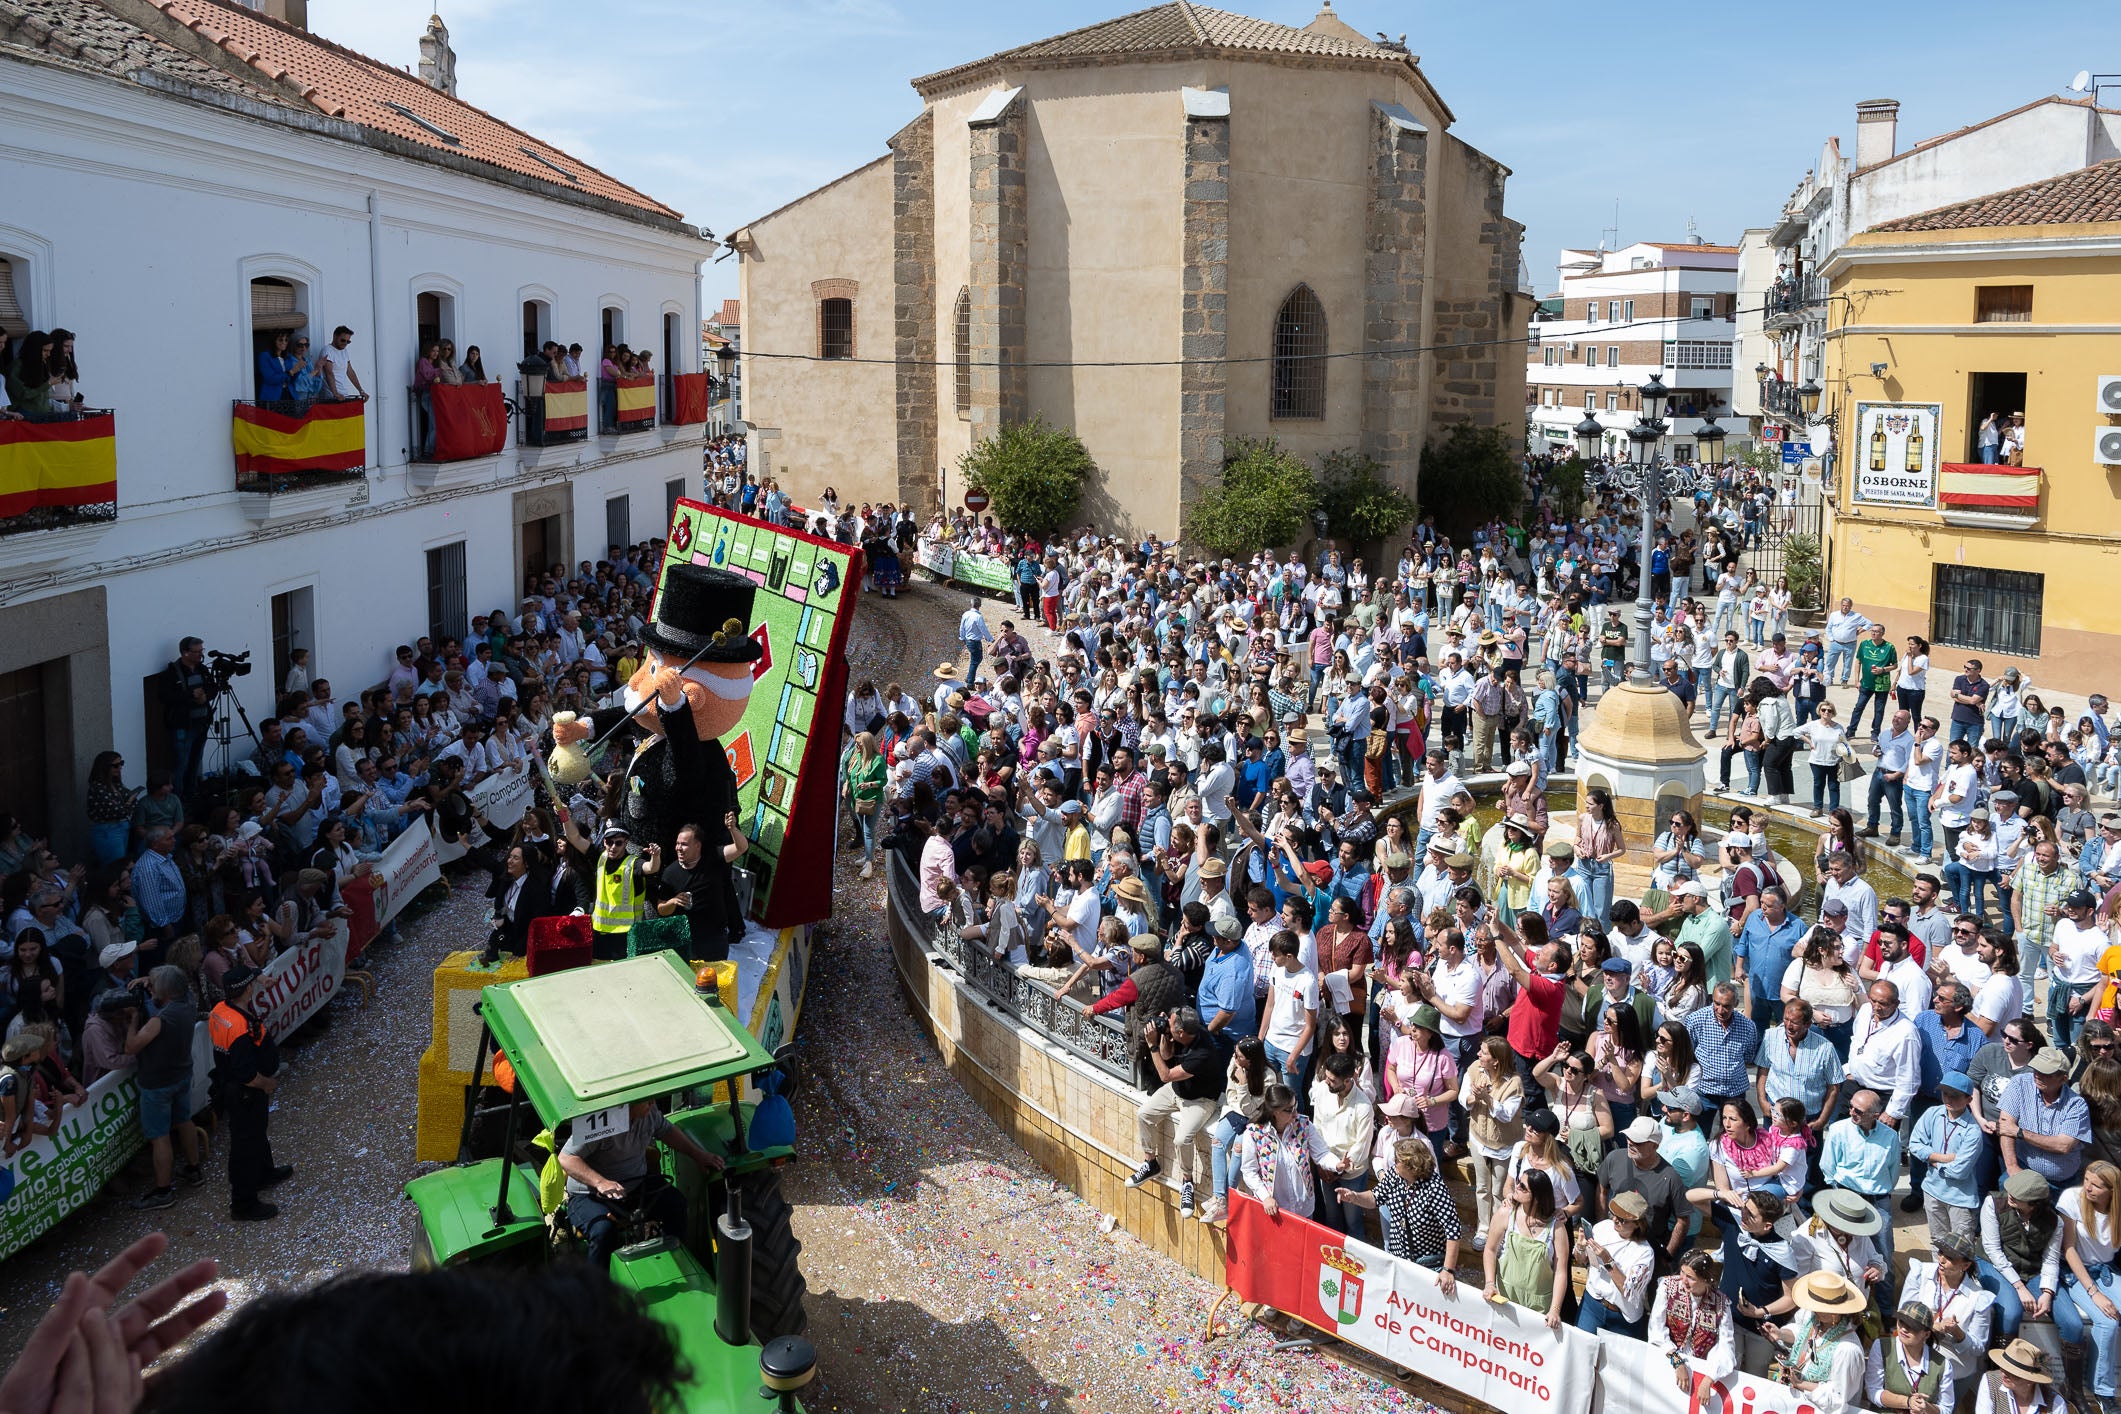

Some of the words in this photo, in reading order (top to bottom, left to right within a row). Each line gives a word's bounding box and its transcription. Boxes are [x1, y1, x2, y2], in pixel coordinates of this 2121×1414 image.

[1862, 476, 1928, 489] OSBORNE
[1890, 489, 1906, 497] SANTA
[584, 1128, 615, 1140] MONOPOLY
[586, 1111, 608, 1130] 11
[46, 1141, 93, 1179] Caballos
[15, 1199, 57, 1233] Sentimiento
[57, 1176, 101, 1219] Baile
[22, 1186, 60, 1216] Pucha
[59, 1165, 87, 1194] Fe
[1386, 1289, 1545, 1368] Ayuntamiento
[1374, 1313, 1402, 1336] de
[1410, 1325, 1551, 1402] Campanario
